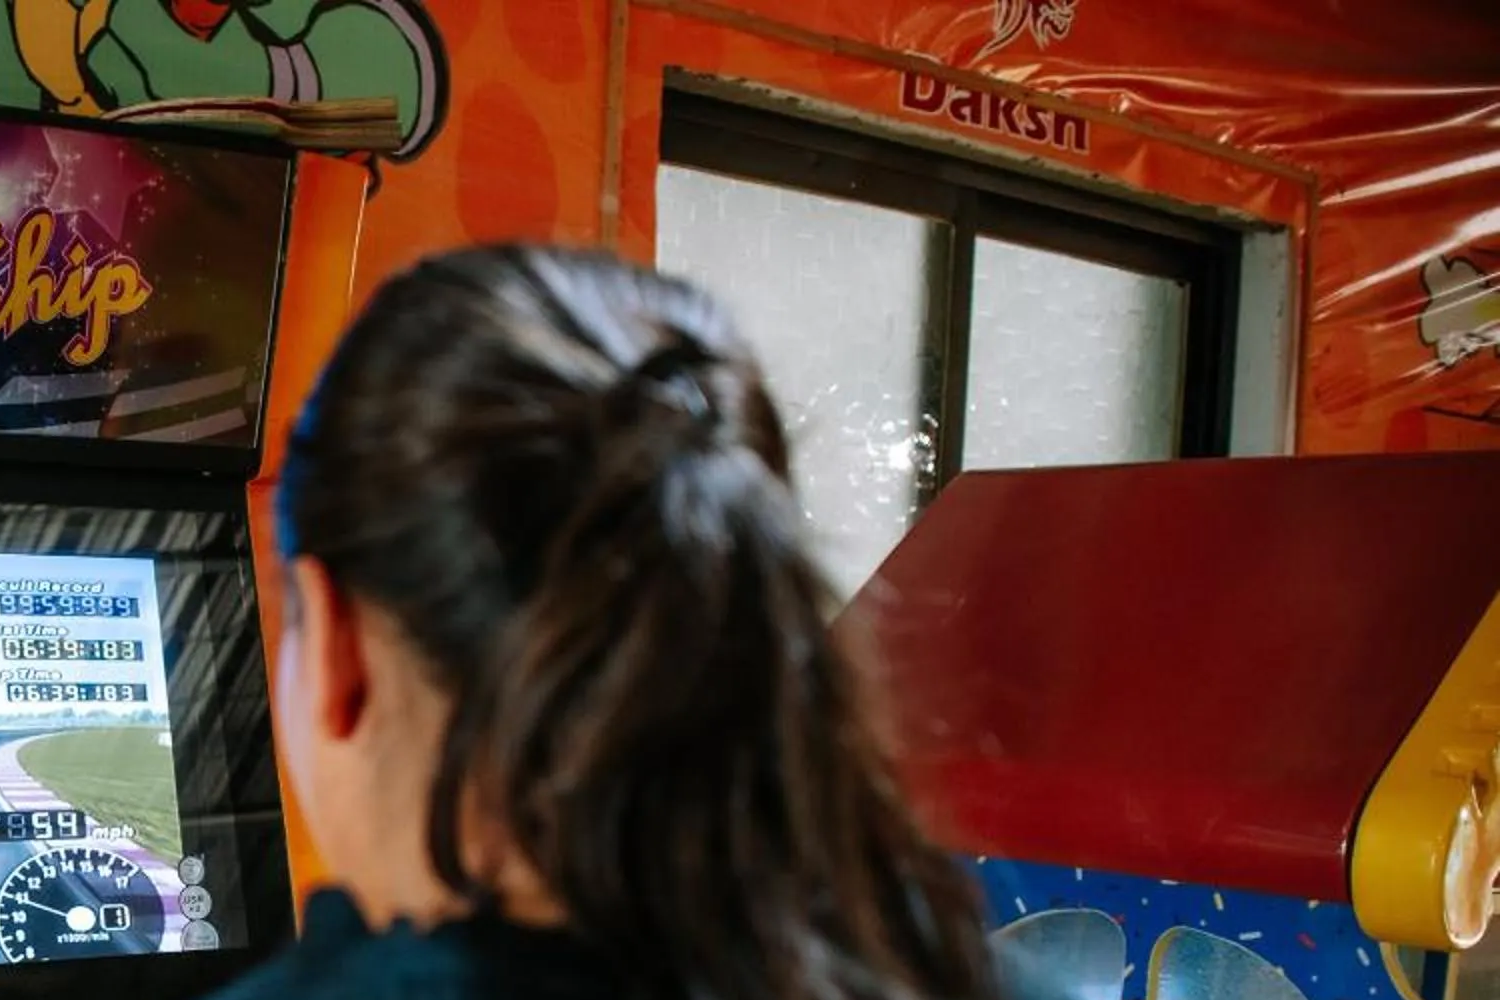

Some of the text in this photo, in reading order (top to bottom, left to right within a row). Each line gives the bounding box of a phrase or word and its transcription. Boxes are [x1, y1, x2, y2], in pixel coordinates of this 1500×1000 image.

[37, 580, 104, 594] Record
[24, 622, 70, 637] Time
[16, 668, 63, 681] Time
[91, 823, 134, 841] mph
